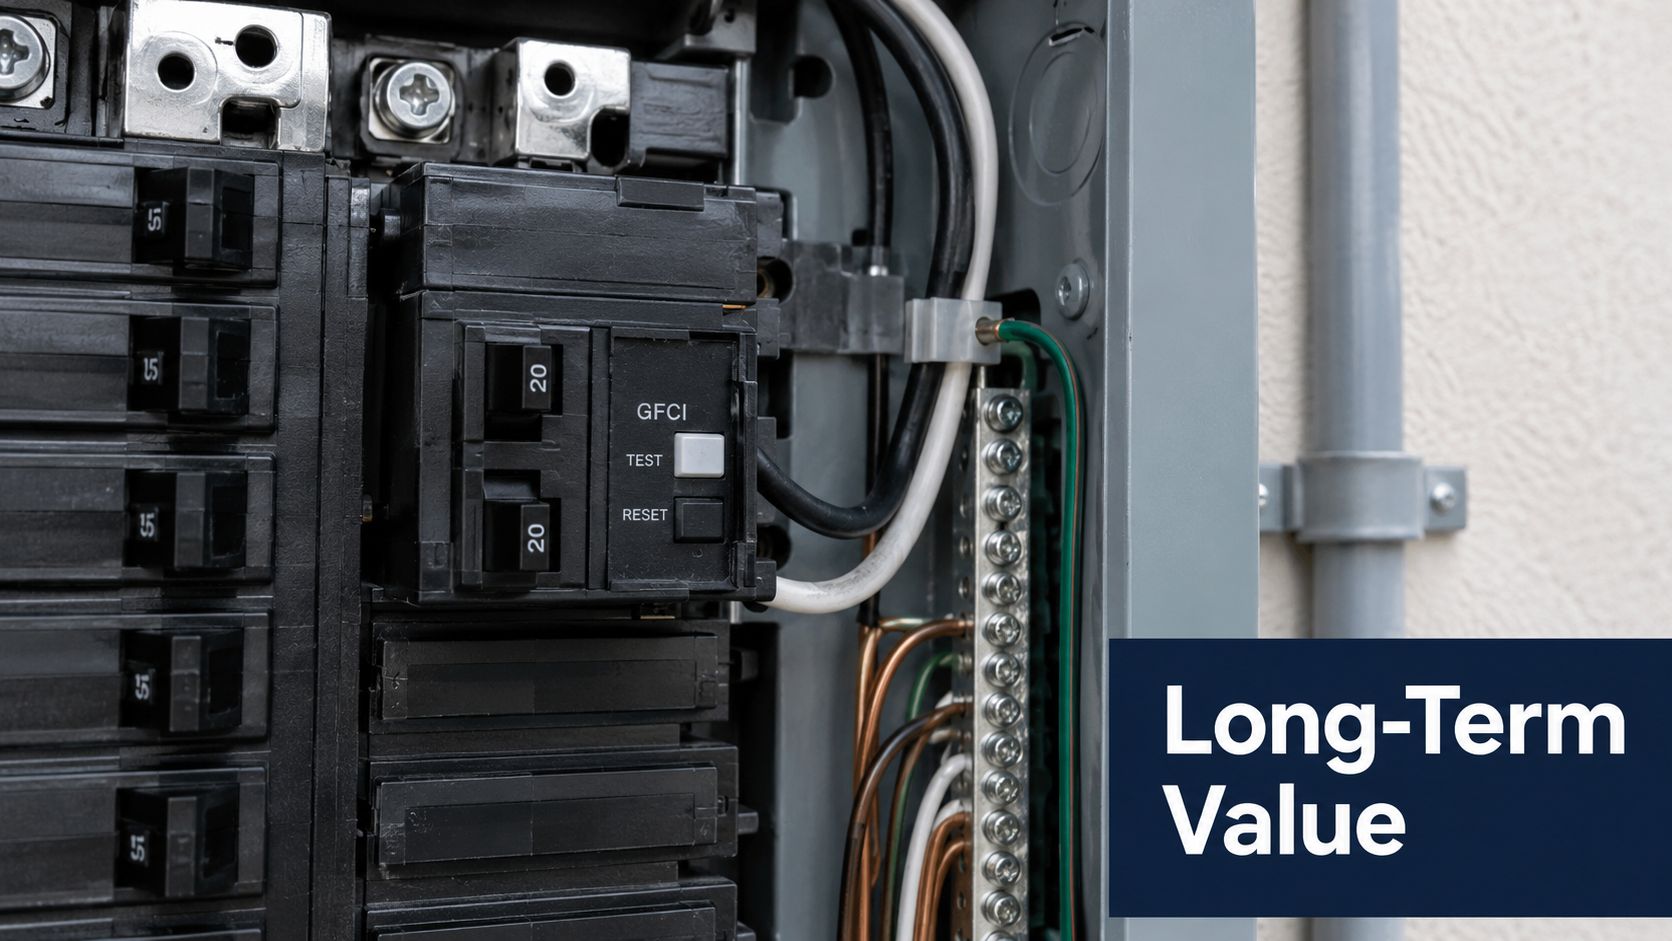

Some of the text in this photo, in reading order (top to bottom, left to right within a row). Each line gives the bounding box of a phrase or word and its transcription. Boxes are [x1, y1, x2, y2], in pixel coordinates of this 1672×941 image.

[529, 364, 548, 394] 20
[636, 402, 688, 421] GFCI
[625, 453, 664, 468] TEST
[622, 507, 669, 522] RESET
[527, 522, 546, 554] 20
